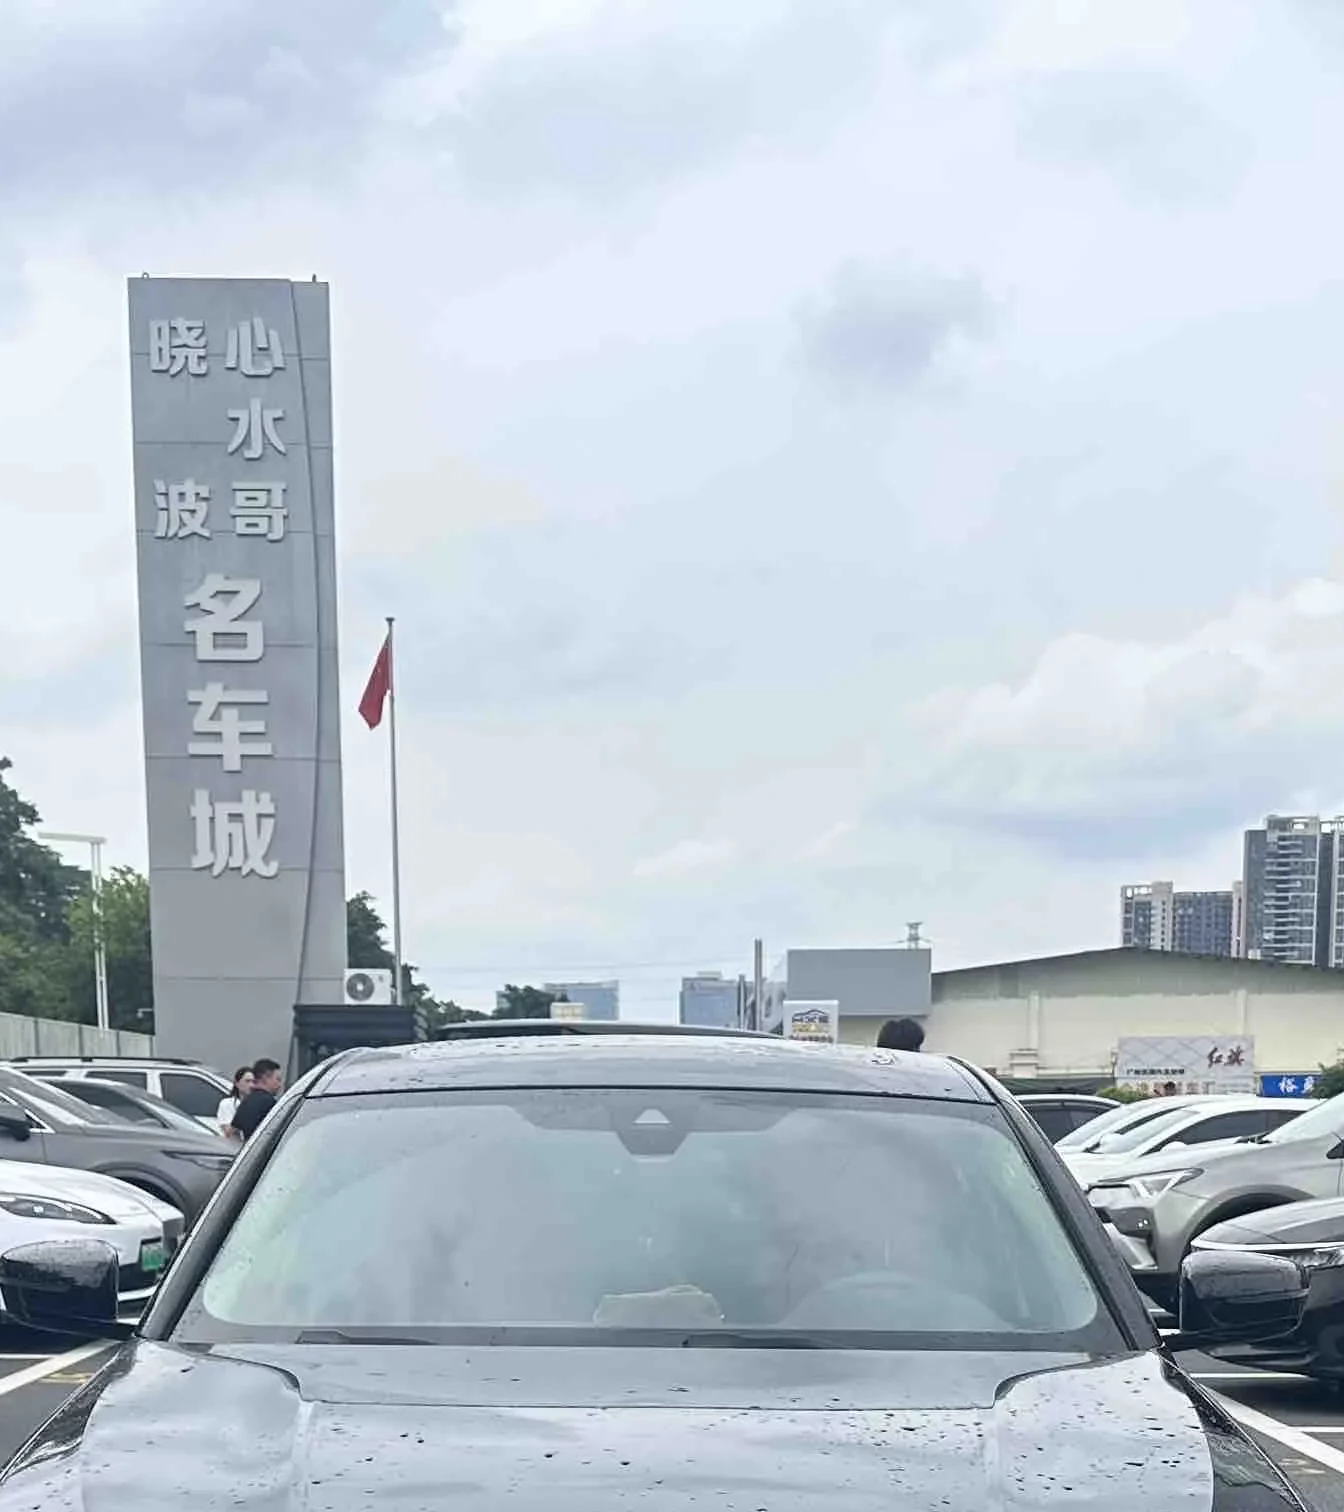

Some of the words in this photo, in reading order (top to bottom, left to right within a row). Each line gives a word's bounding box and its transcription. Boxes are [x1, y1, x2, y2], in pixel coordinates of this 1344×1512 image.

[149, 317, 212, 541] 晓波
[224, 317, 290, 542] 心水哥
[183, 573, 280, 879] 名车城
